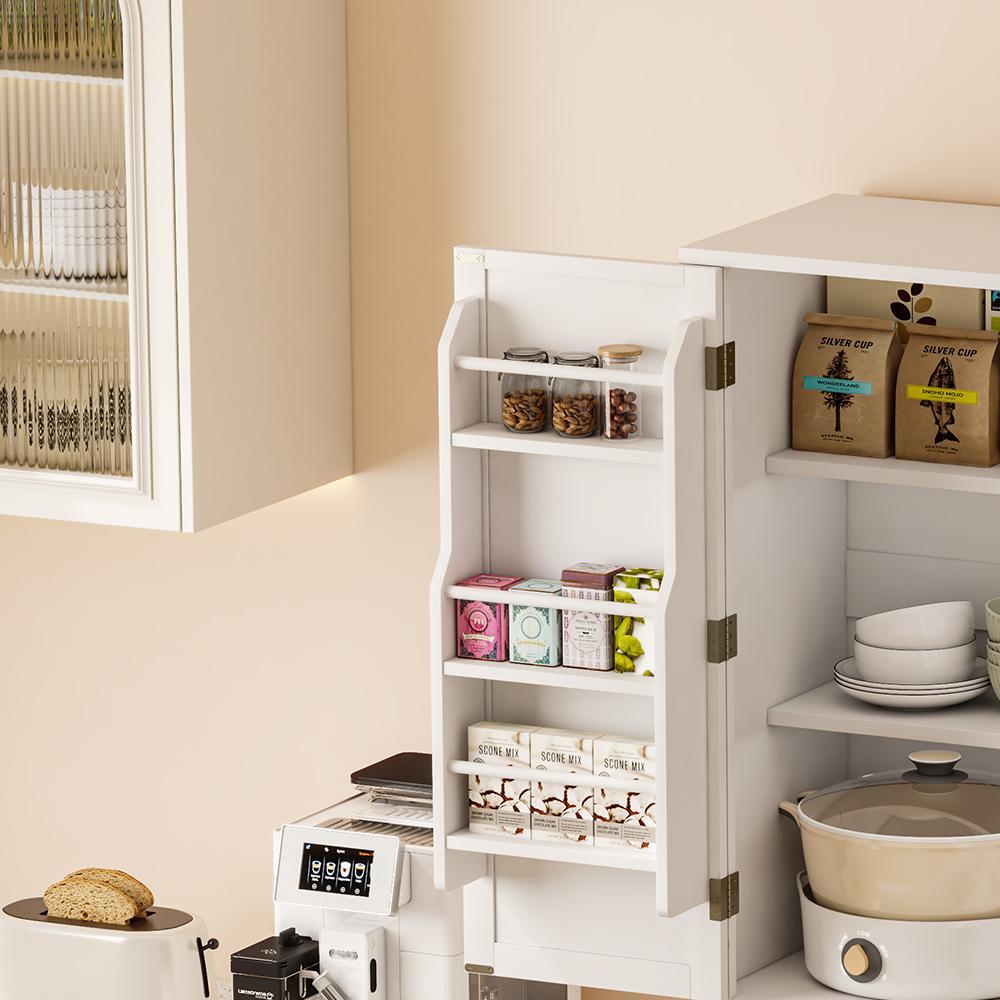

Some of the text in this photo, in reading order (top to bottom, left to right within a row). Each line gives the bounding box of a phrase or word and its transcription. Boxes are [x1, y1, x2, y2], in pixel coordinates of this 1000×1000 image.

[820, 336, 874, 350] SILVER CUP
[923, 345, 978, 358] SILVER CUP
[816, 380, 860, 389] WONDERLAND
[478, 744, 520, 758] SCONE MIX
[541, 751, 583, 765] SCONE MIX
[604, 758, 646, 772] SCONE MIX
